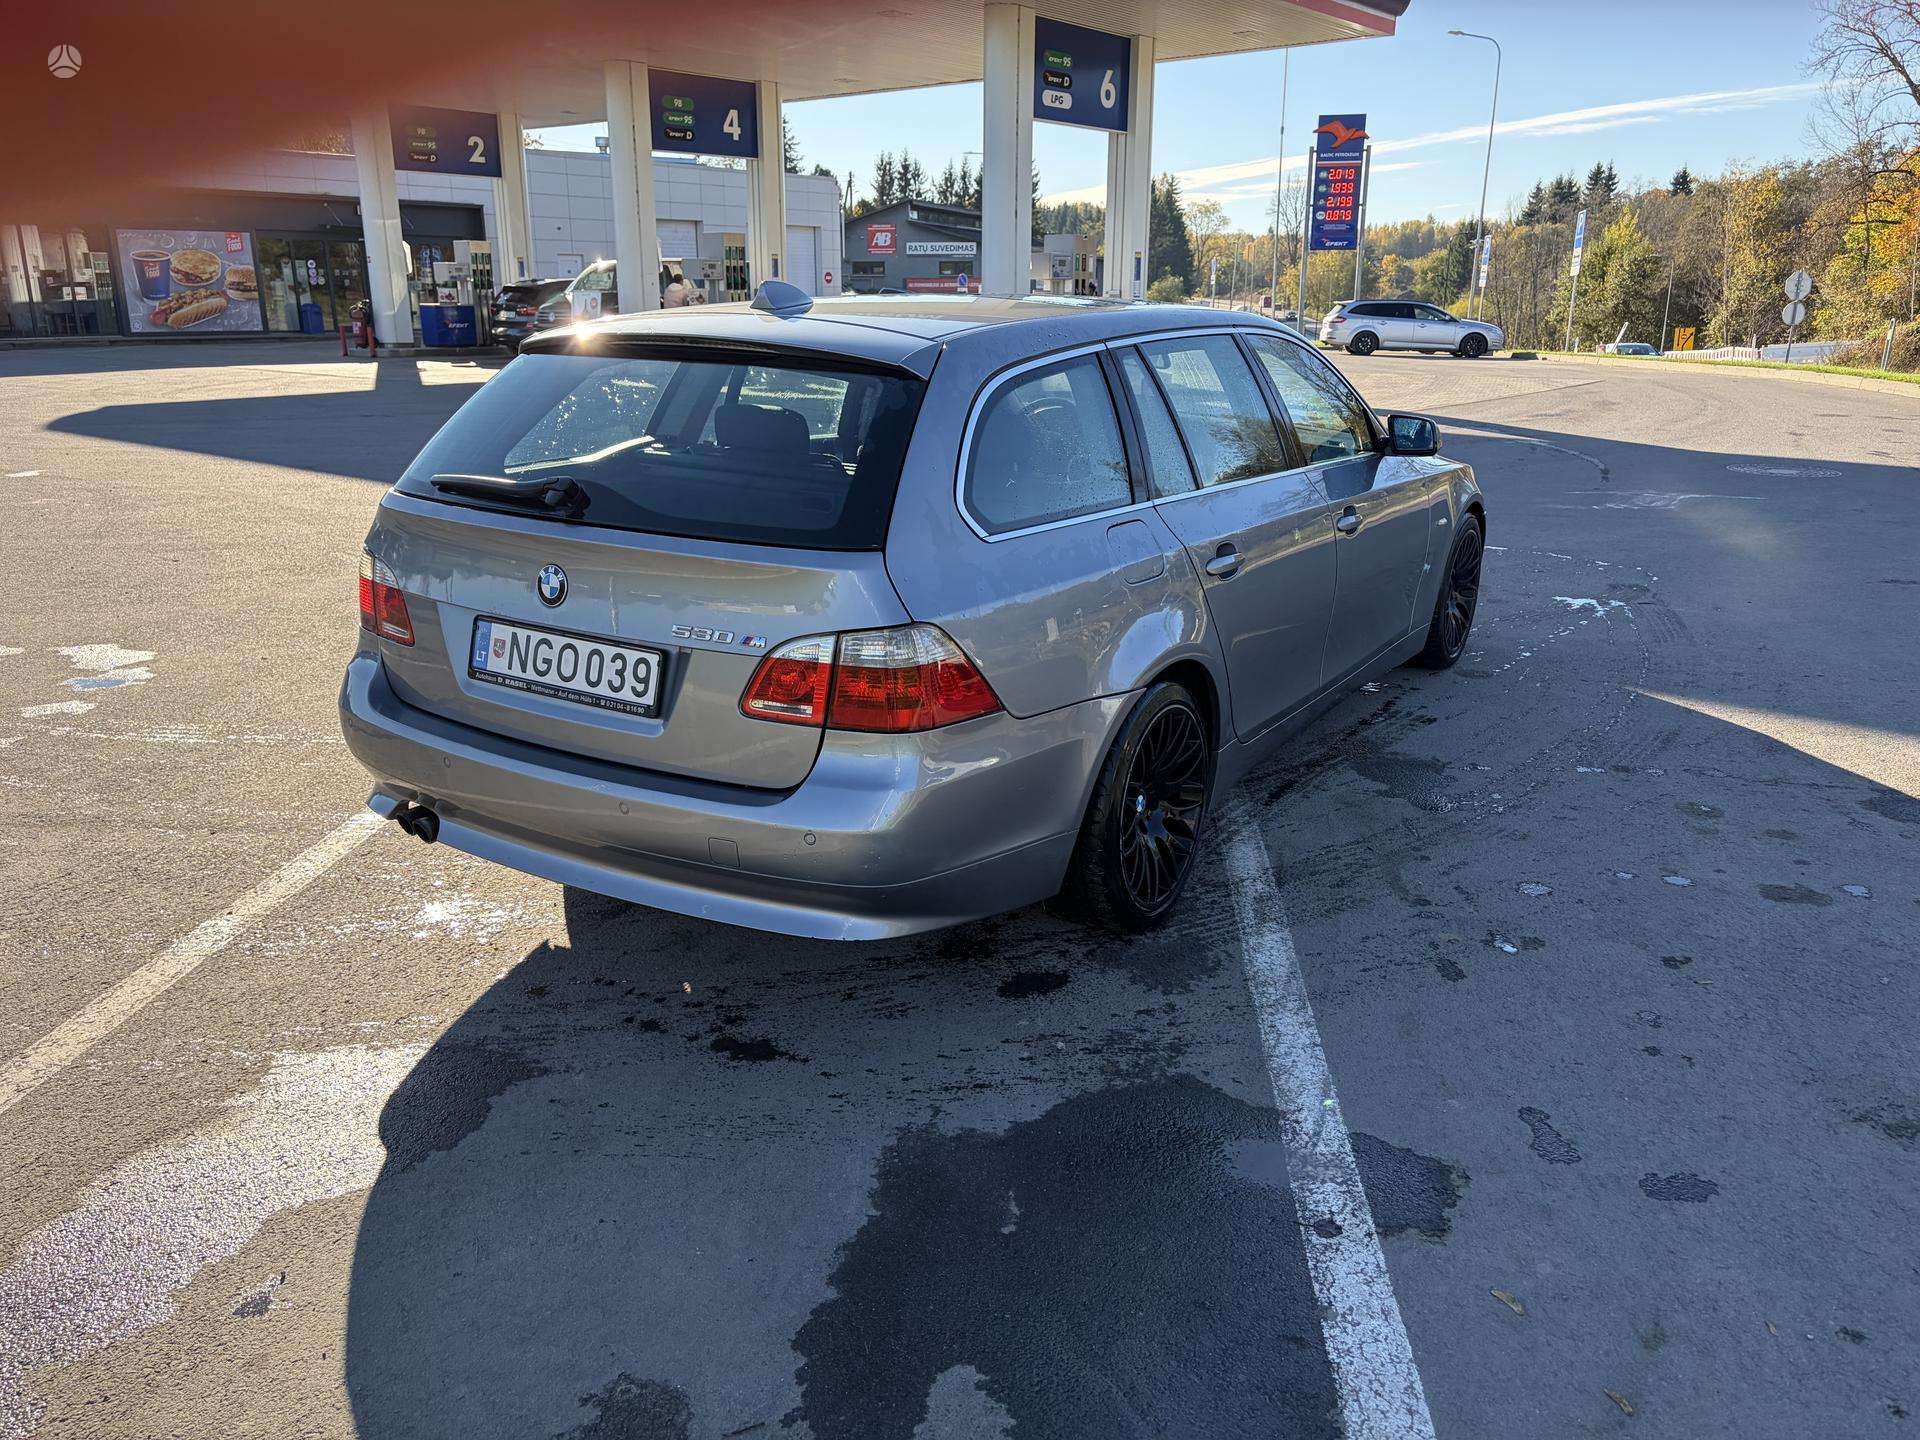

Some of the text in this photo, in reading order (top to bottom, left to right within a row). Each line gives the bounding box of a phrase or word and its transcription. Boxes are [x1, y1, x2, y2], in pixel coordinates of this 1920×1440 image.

[1063, 57, 1072, 67] 95
[1063, 77, 1070, 86] D
[1100, 69, 1116, 109] 6
[673, 98, 683, 107] 98
[1051, 94, 1064, 104] LPG
[683, 115, 693, 124] 95
[723, 109, 741, 141] 4
[686, 131, 693, 140] D
[427, 141, 436, 149] 95
[467, 135, 486, 163] 2
[430, 154, 437, 162] D
[930, 244, 975, 252] SUVEDIMAS
[671, 624, 734, 644] 530
[475, 651, 487, 662] LT
